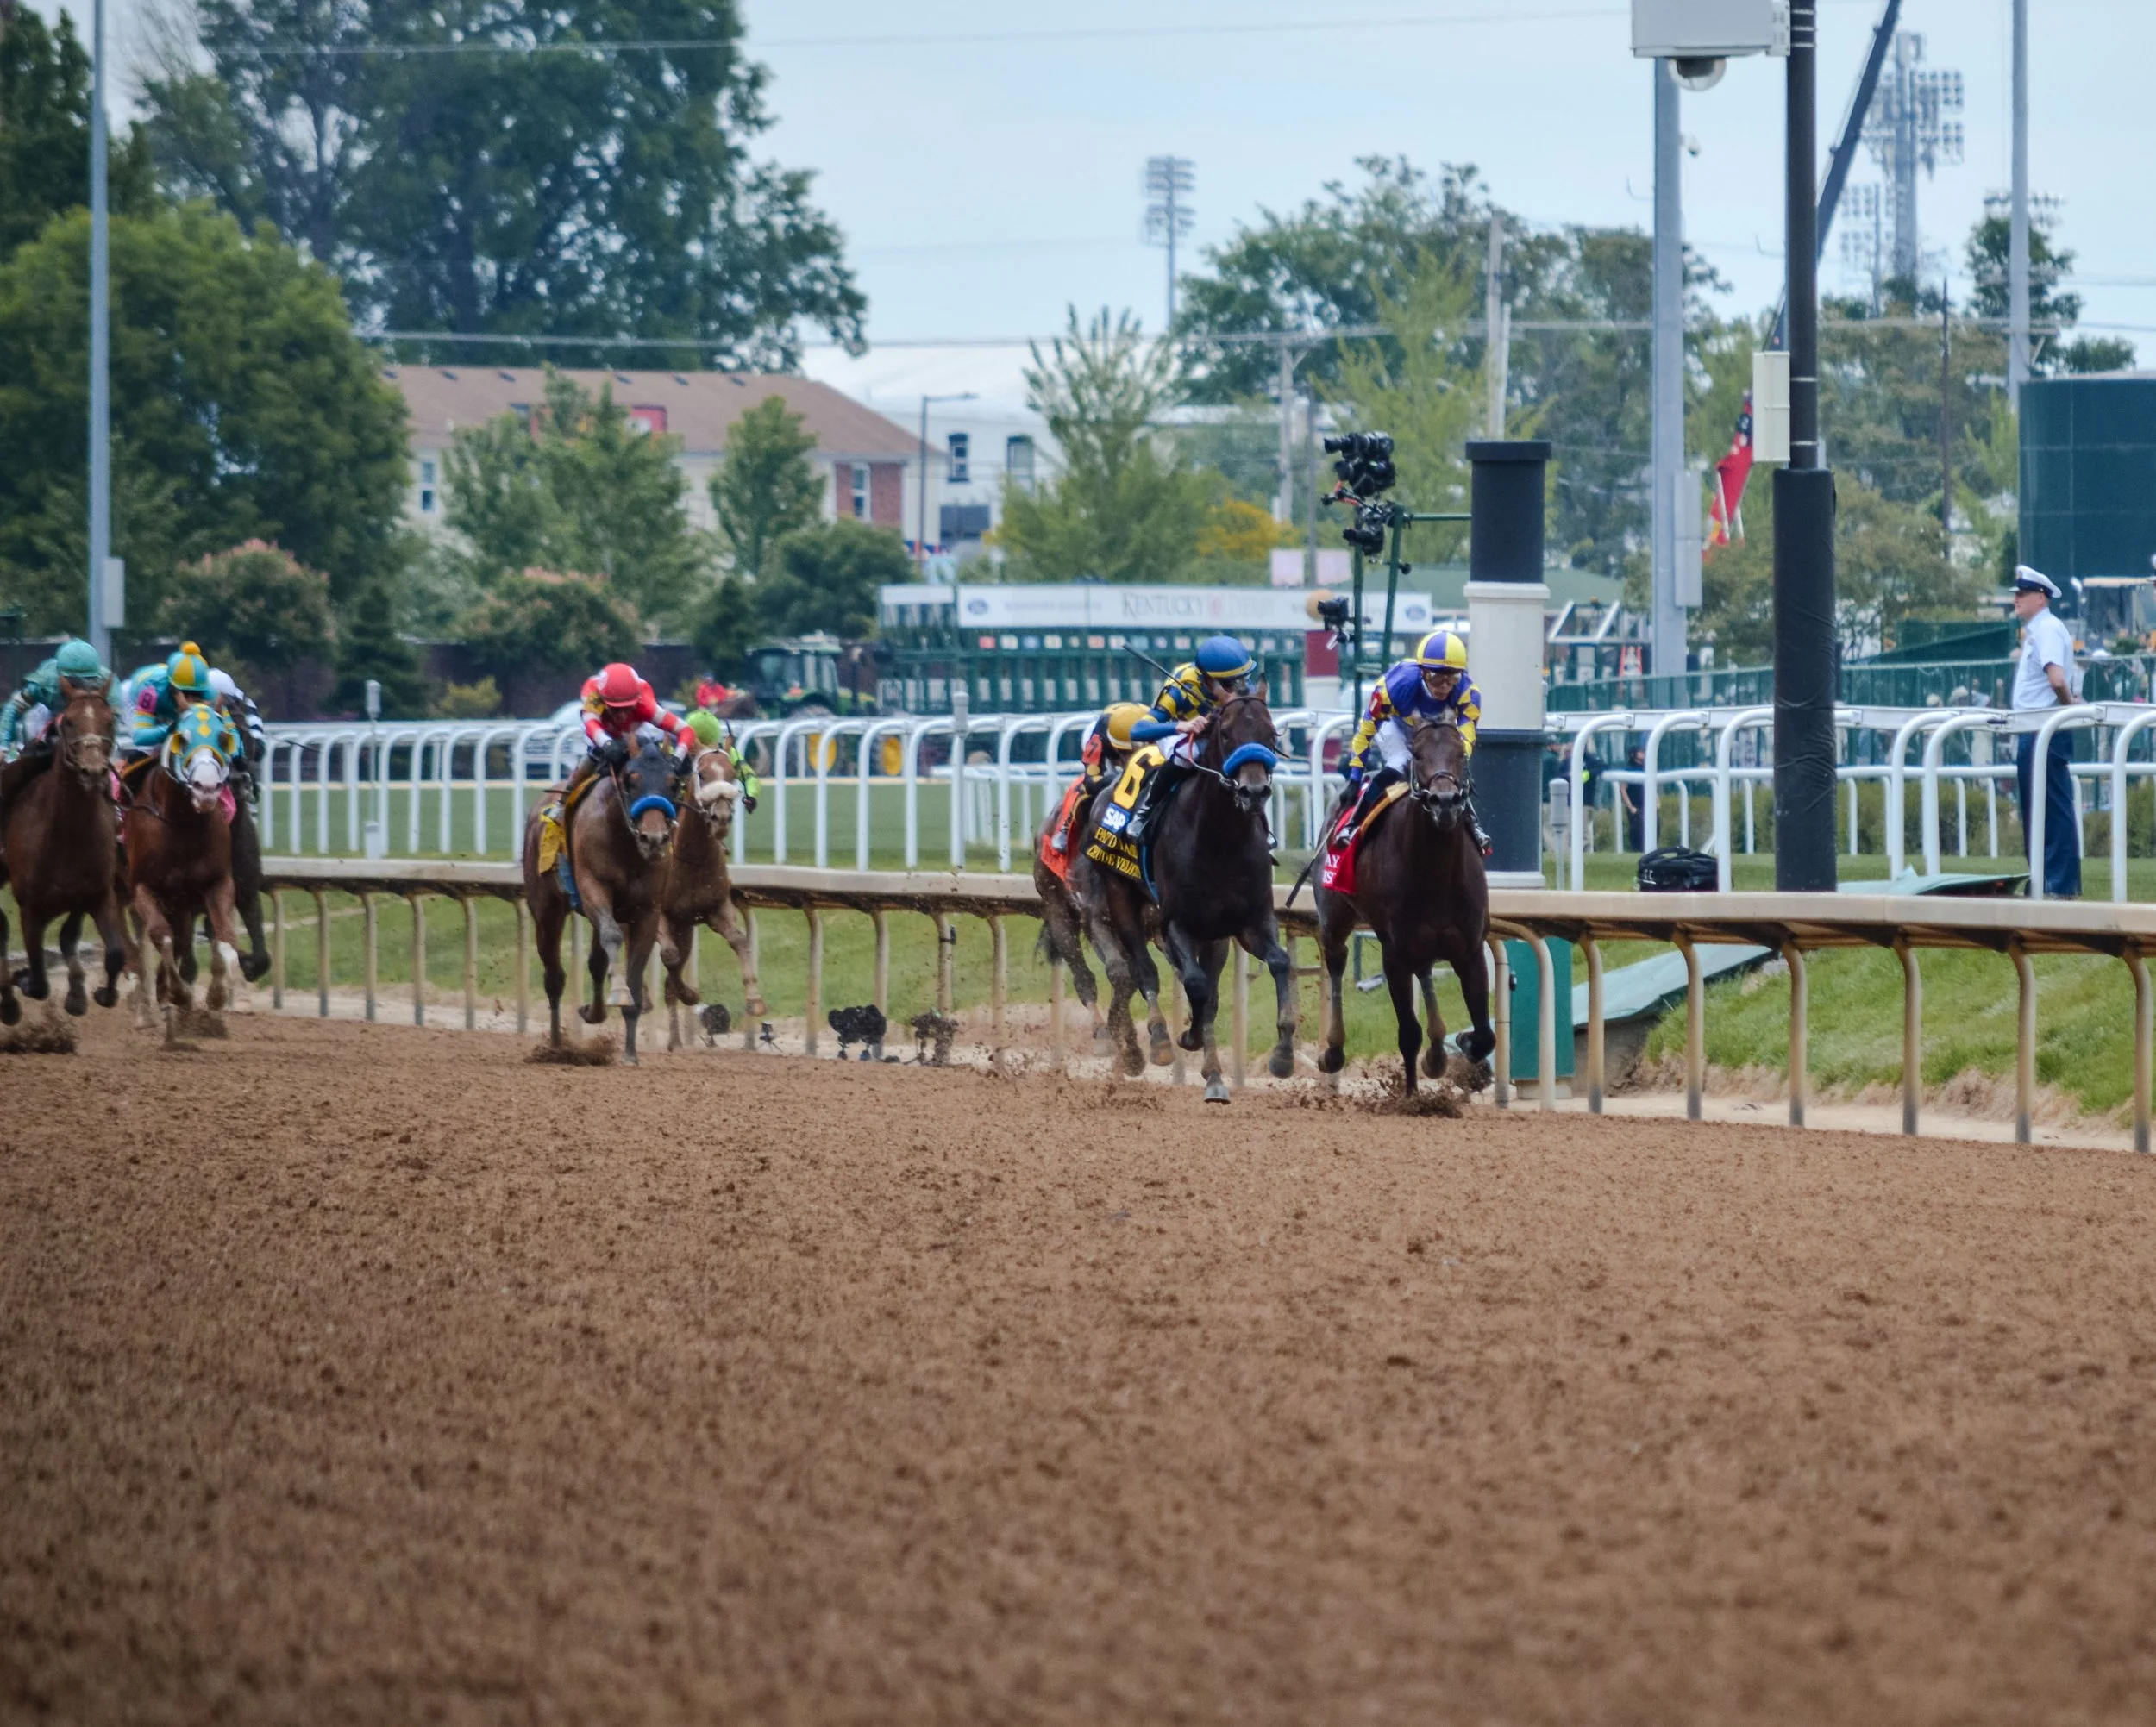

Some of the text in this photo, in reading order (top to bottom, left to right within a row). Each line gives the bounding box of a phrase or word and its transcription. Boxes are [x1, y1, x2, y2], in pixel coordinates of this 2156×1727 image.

[1122, 592, 1203, 618] KENTUCKY
[142, 692, 153, 709] 8
[1113, 745, 1166, 809] 6
[1102, 807, 1126, 830] SAP
